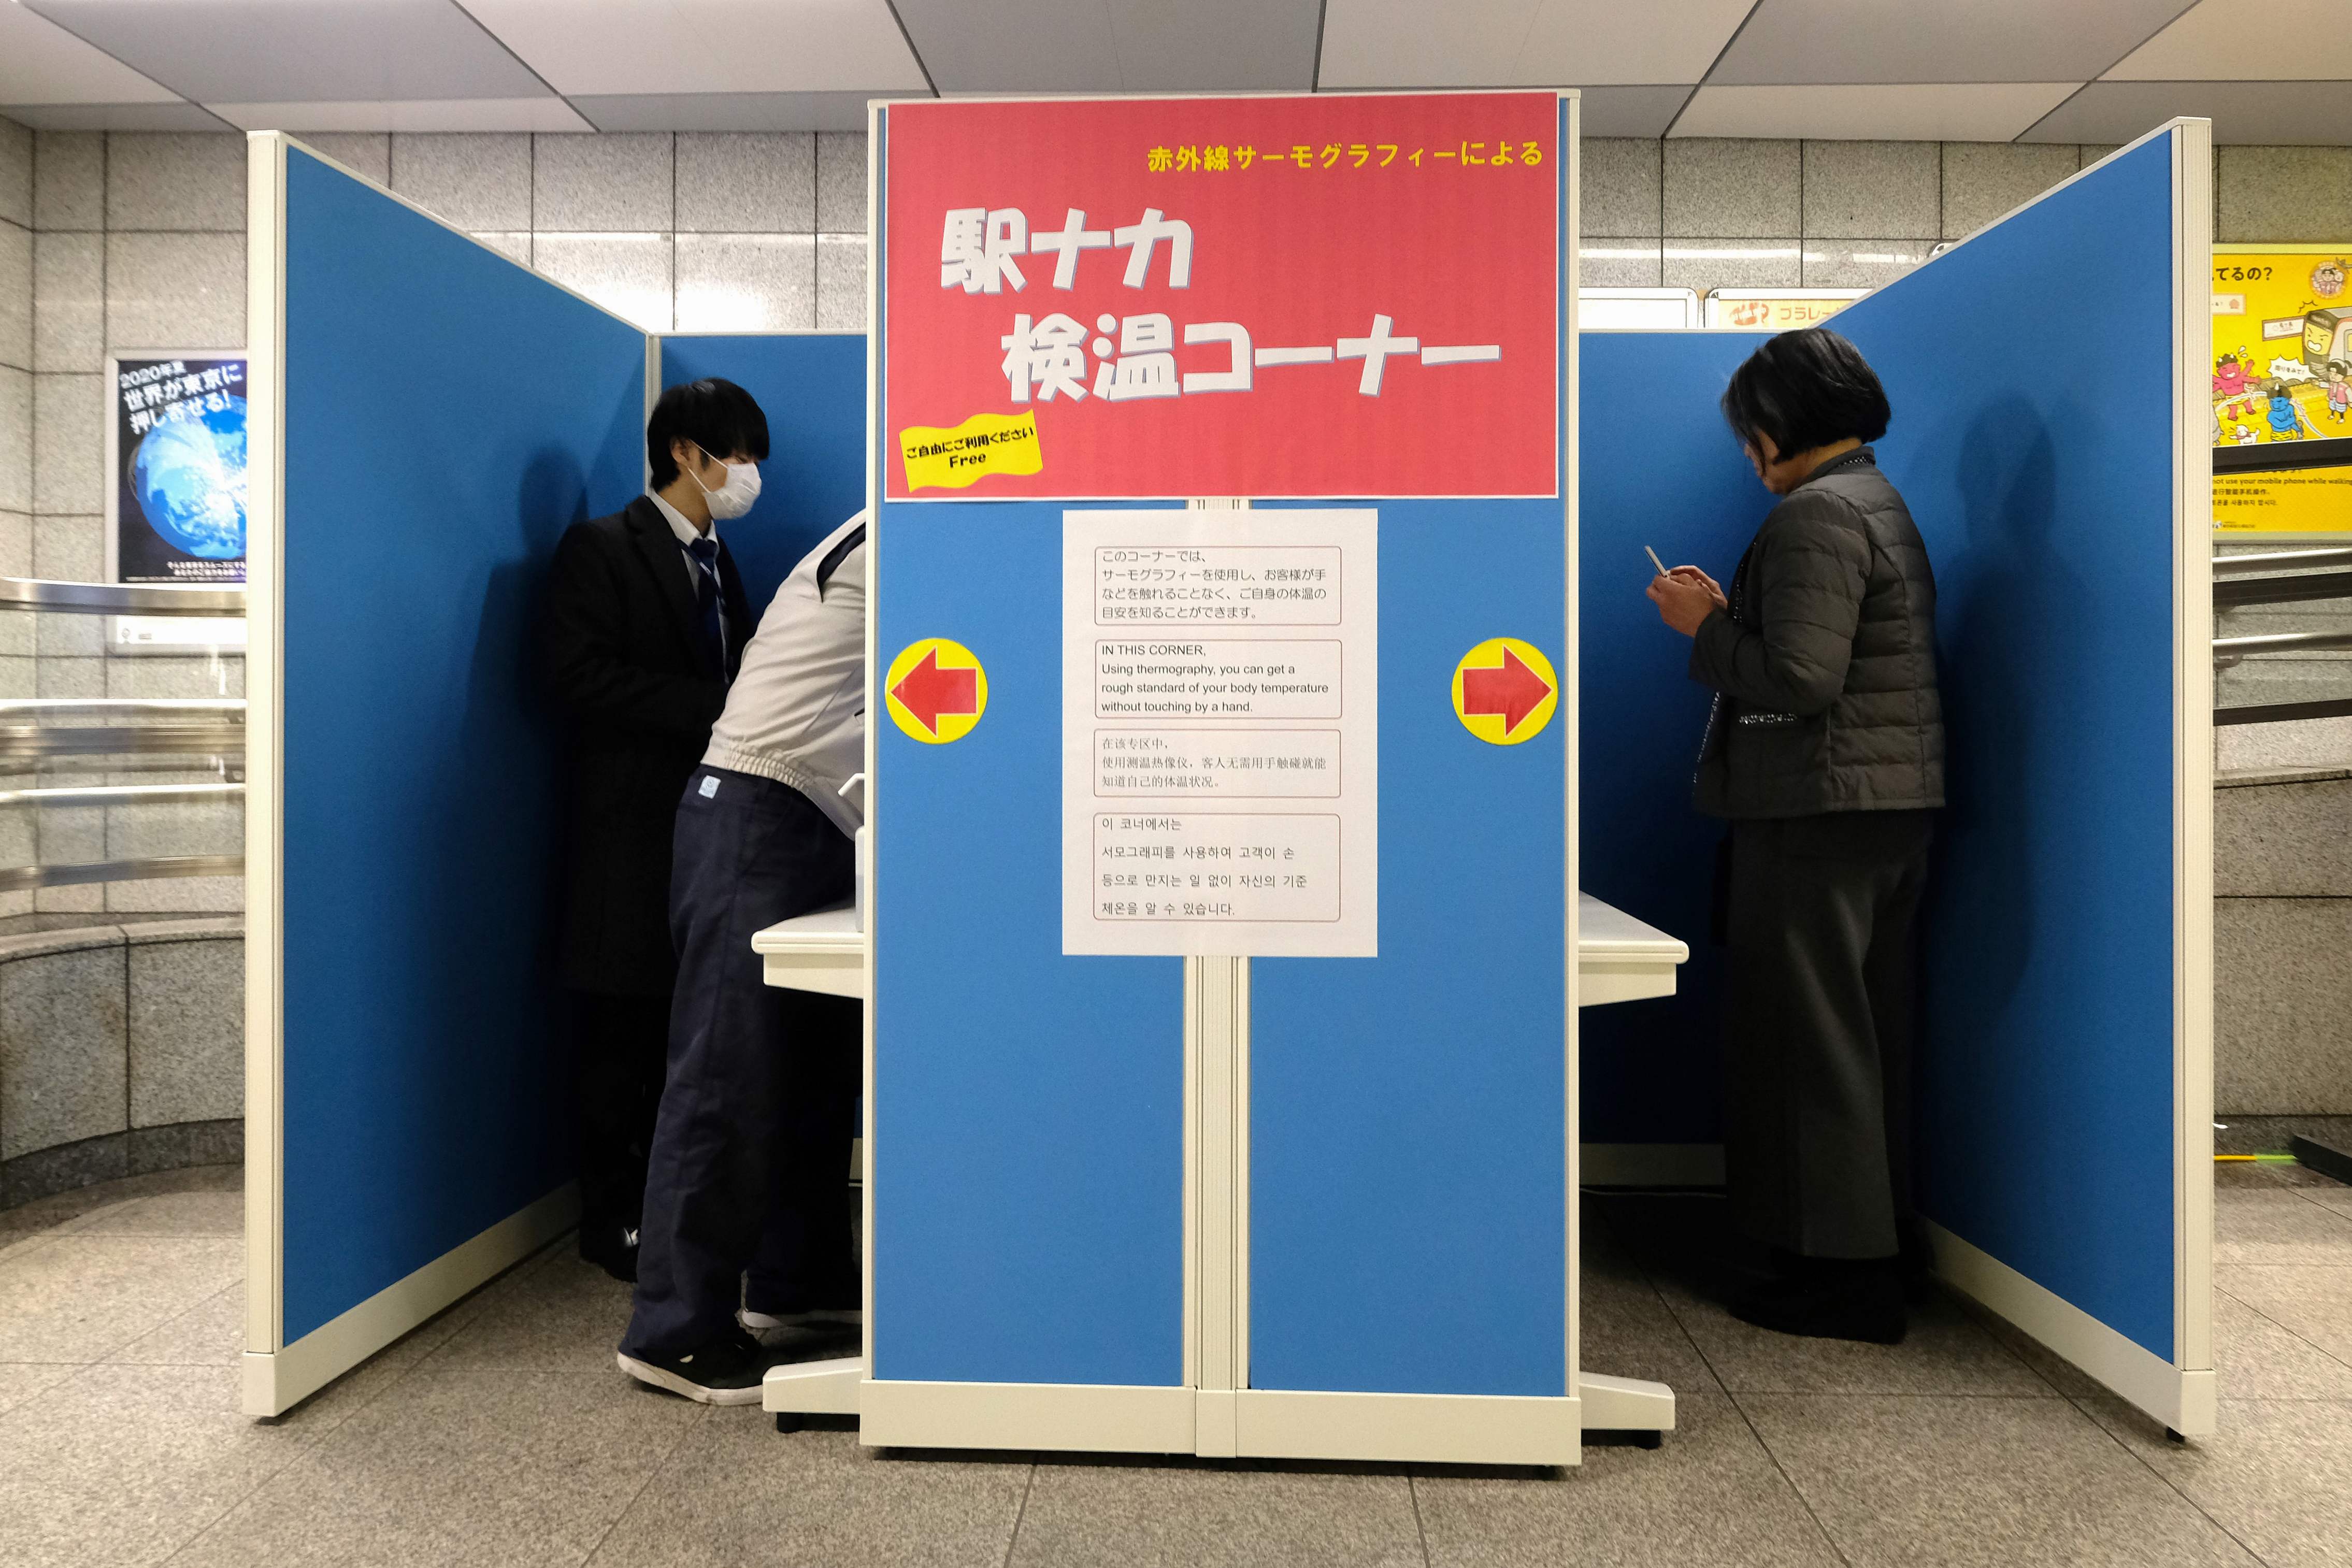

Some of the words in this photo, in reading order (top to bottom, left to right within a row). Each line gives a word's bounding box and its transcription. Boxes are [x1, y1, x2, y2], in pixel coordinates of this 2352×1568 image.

[1148, 141, 1543, 172] 赤外線サーモグラフィーによる
[940, 207, 1194, 295] 駅ナカ
[2213, 267, 2273, 281] てるの?
[1000, 312, 1502, 402] 検温コーナー
[123, 364, 242, 412] 世界が東京に
[907, 426, 1034, 459] ご自由にご利用ください
[949, 453, 986, 468] Free
[2284, 478, 2305, 486] phone
[1103, 551, 1206, 563] このコーナーでは、
[1102, 569, 1326, 581] サーモグラフィーを使用し、お客様が手
[1102, 588, 1326, 599] などを触れることなく、ご自身の体温の
[1102, 607, 1256, 618] 目安を知ることができます。
[1102, 645, 1113, 655] IN
[1117, 645, 1145, 655] THIS
[1150, 645, 1206, 656] CORNER,
[1102, 664, 1133, 676] Using
[1137, 664, 1215, 676] thermography,
[1220, 666, 1240, 676] you
[1244, 666, 1263, 674] can
[1267, 665, 1284, 676] get
[1288, 666, 1295, 674] a
[1101, 683, 1133, 695] rough
[1137, 682, 1185, 693] standard
[1189, 682, 1199, 693] of
[1202, 685, 1227, 695] your
[1230, 683, 1258, 695] body
[1261, 683, 1329, 696] temperature
[1101, 701, 1141, 712] without
[1145, 701, 1191, 714] touching
[1195, 701, 1208, 714] by
[1222, 701, 1253, 712] hand.
[1102, 775, 1219, 787] 知道自己的体温状况。
[1102, 818, 1112, 830] 이
[1121, 818, 1182, 830] 코너에서는
[1102, 846, 1175, 859] 서모그래피를
[1183, 846, 1231, 859] 사용하여
[1239, 846, 1275, 859] 고객이
[1283, 847, 1294, 859] 손
[1102, 874, 1138, 886] 등으로
[1145, 874, 1182, 887] 만지는
[1190, 875, 1200, 887] 일
[1208, 875, 1231, 887] 없이
[1239, 875, 1275, 888] 자신의
[1284, 875, 1307, 888] 기준
[1102, 902, 1138, 915] 체온을
[1146, 902, 1156, 915] 알
[1164, 903, 1175, 915] 수
[1184, 903, 1235, 916] 있습니다.
